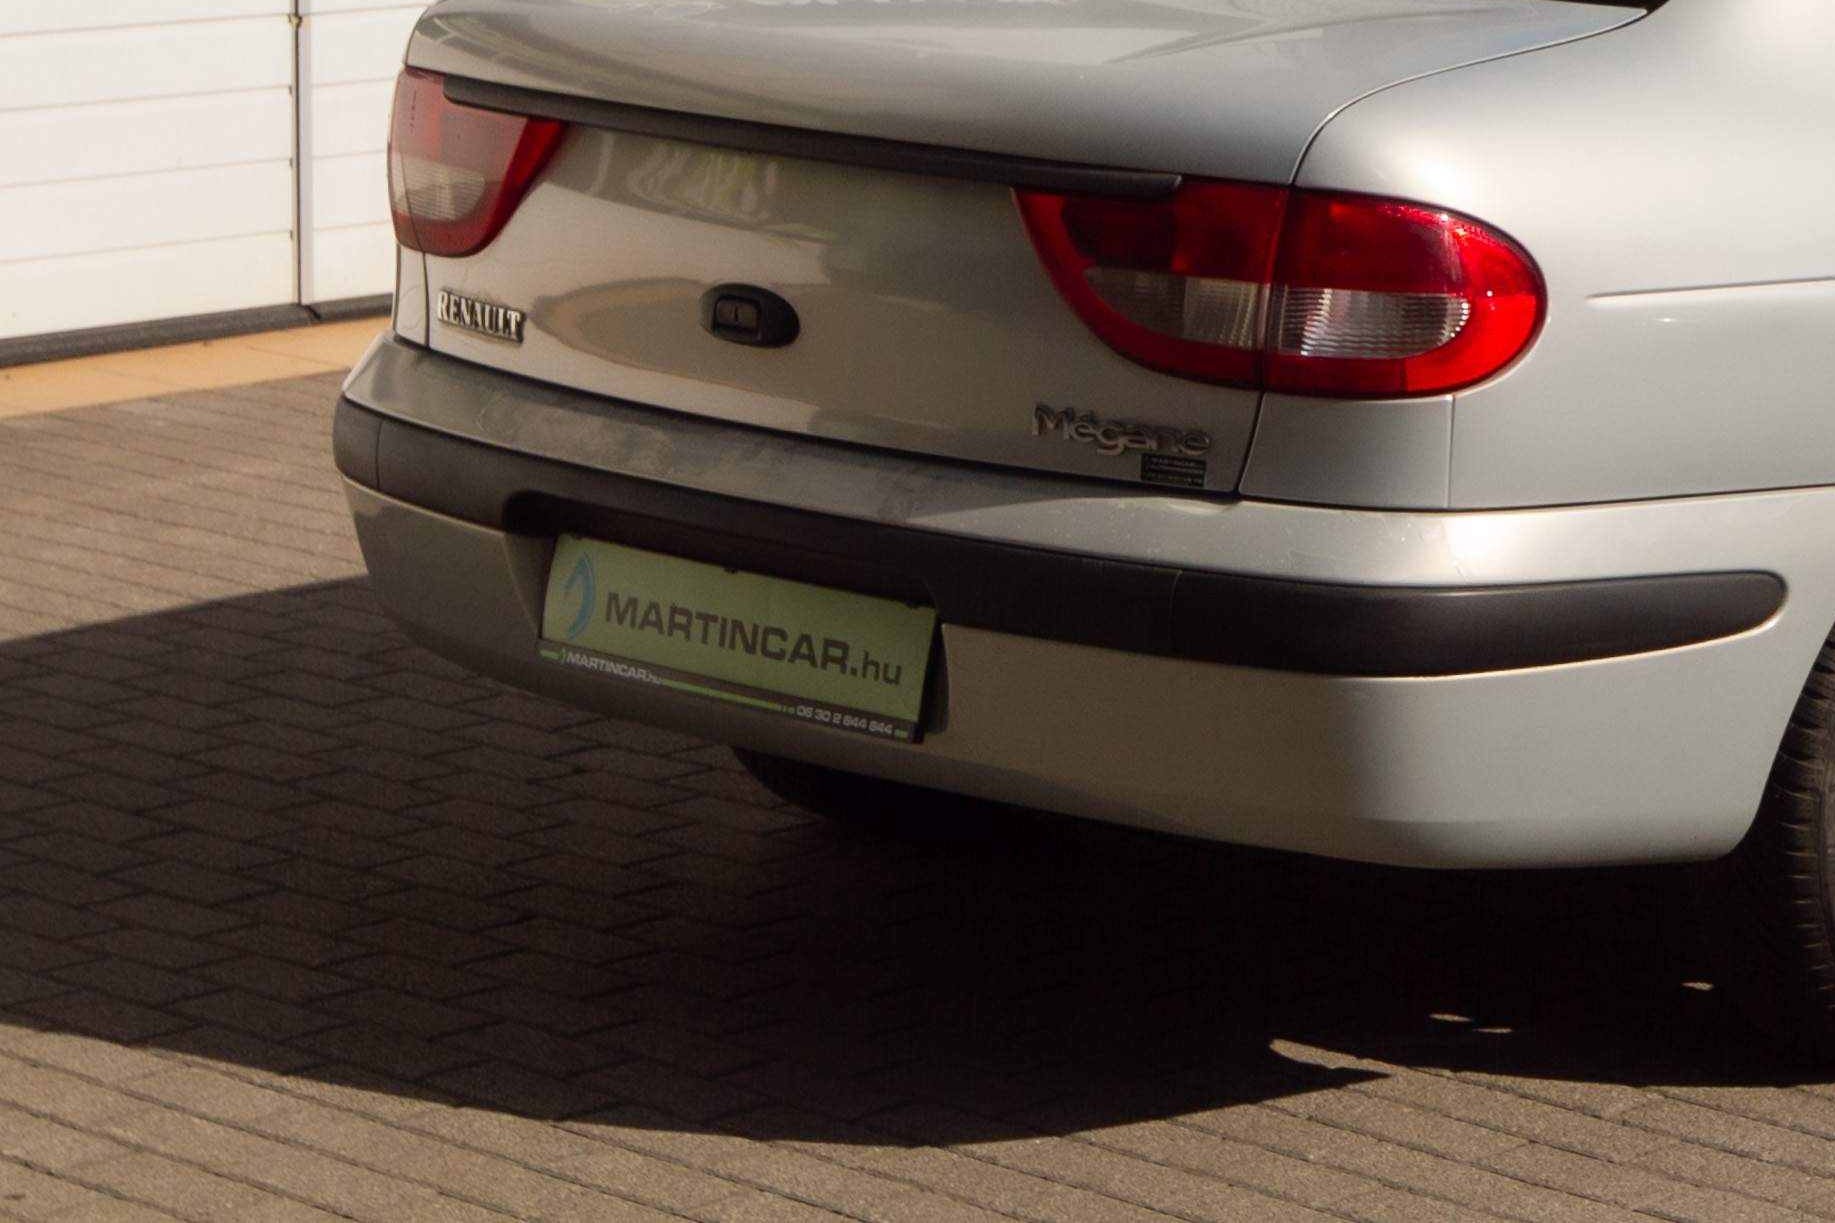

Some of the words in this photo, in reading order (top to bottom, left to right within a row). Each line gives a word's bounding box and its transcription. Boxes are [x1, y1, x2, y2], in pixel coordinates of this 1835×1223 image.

[437, 290, 521, 342] RENAULT
[604, 591, 903, 687] MARTINCAR.hu
[566, 651, 661, 685] MARTINCAR.hu
[814, 709, 832, 722] 30
[832, 713, 841, 725] 2
